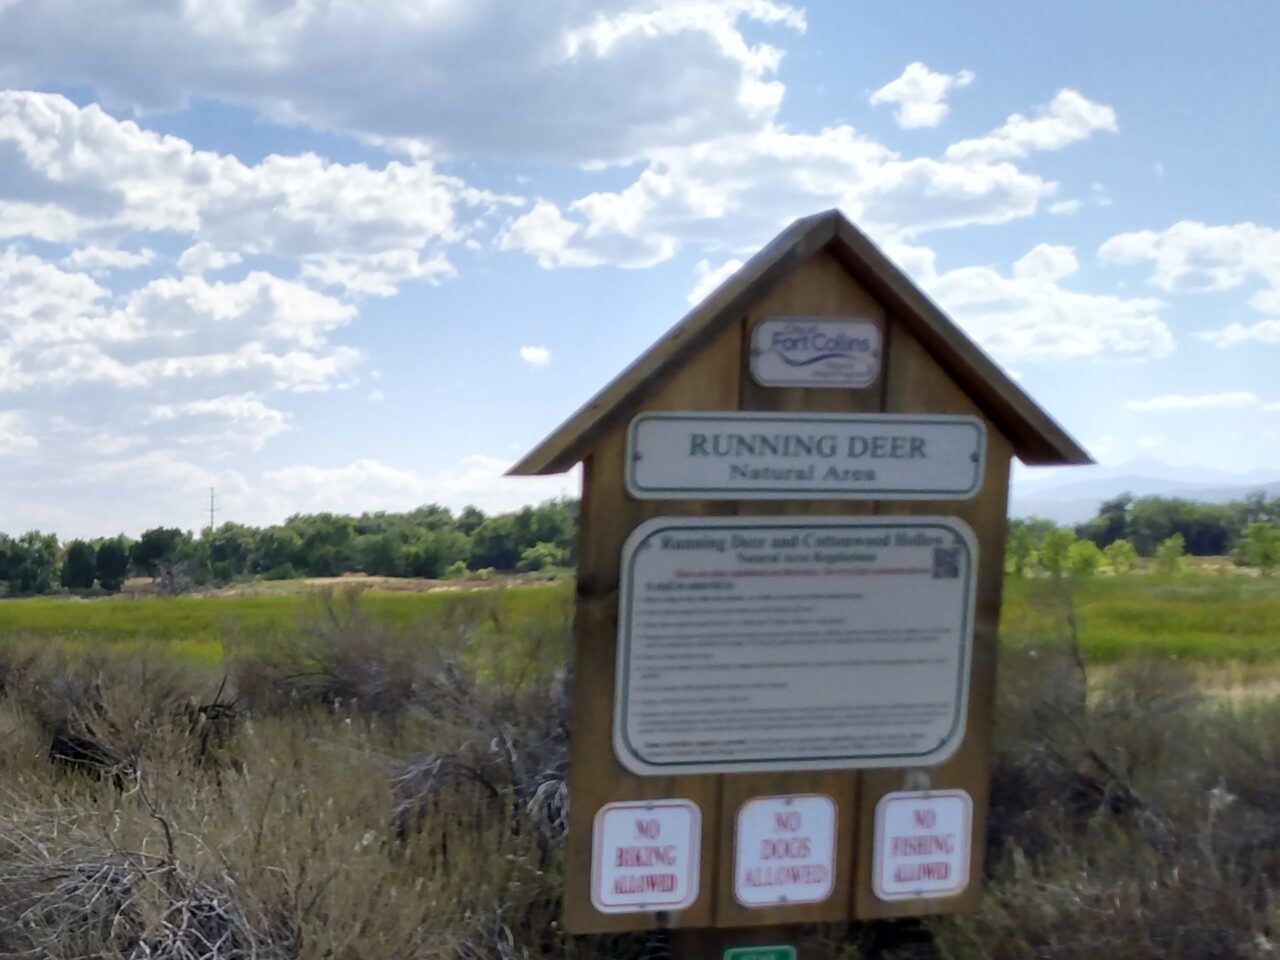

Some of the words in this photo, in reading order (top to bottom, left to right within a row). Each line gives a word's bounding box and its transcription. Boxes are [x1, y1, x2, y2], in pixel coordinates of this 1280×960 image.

[772, 332, 809, 350] Fort
[812, 332, 870, 351] Collins
[688, 433, 838, 458] RUNNING
[847, 435, 927, 458] DEER
[729, 463, 815, 481] Natural
[823, 465, 876, 481] Area
[660, 534, 726, 551] Running
[771, 535, 799, 548] and
[634, 818, 661, 839] NO
[773, 811, 801, 832] NO
[912, 808, 937, 829] NO
[760, 837, 812, 860] DOGS
[891, 833, 956, 857] FISHING
[614, 845, 678, 867] BIKING
[744, 864, 827, 887] ALLOWED
[892, 862, 952, 883] ALLOWED
[613, 873, 678, 894] ALLOWED
